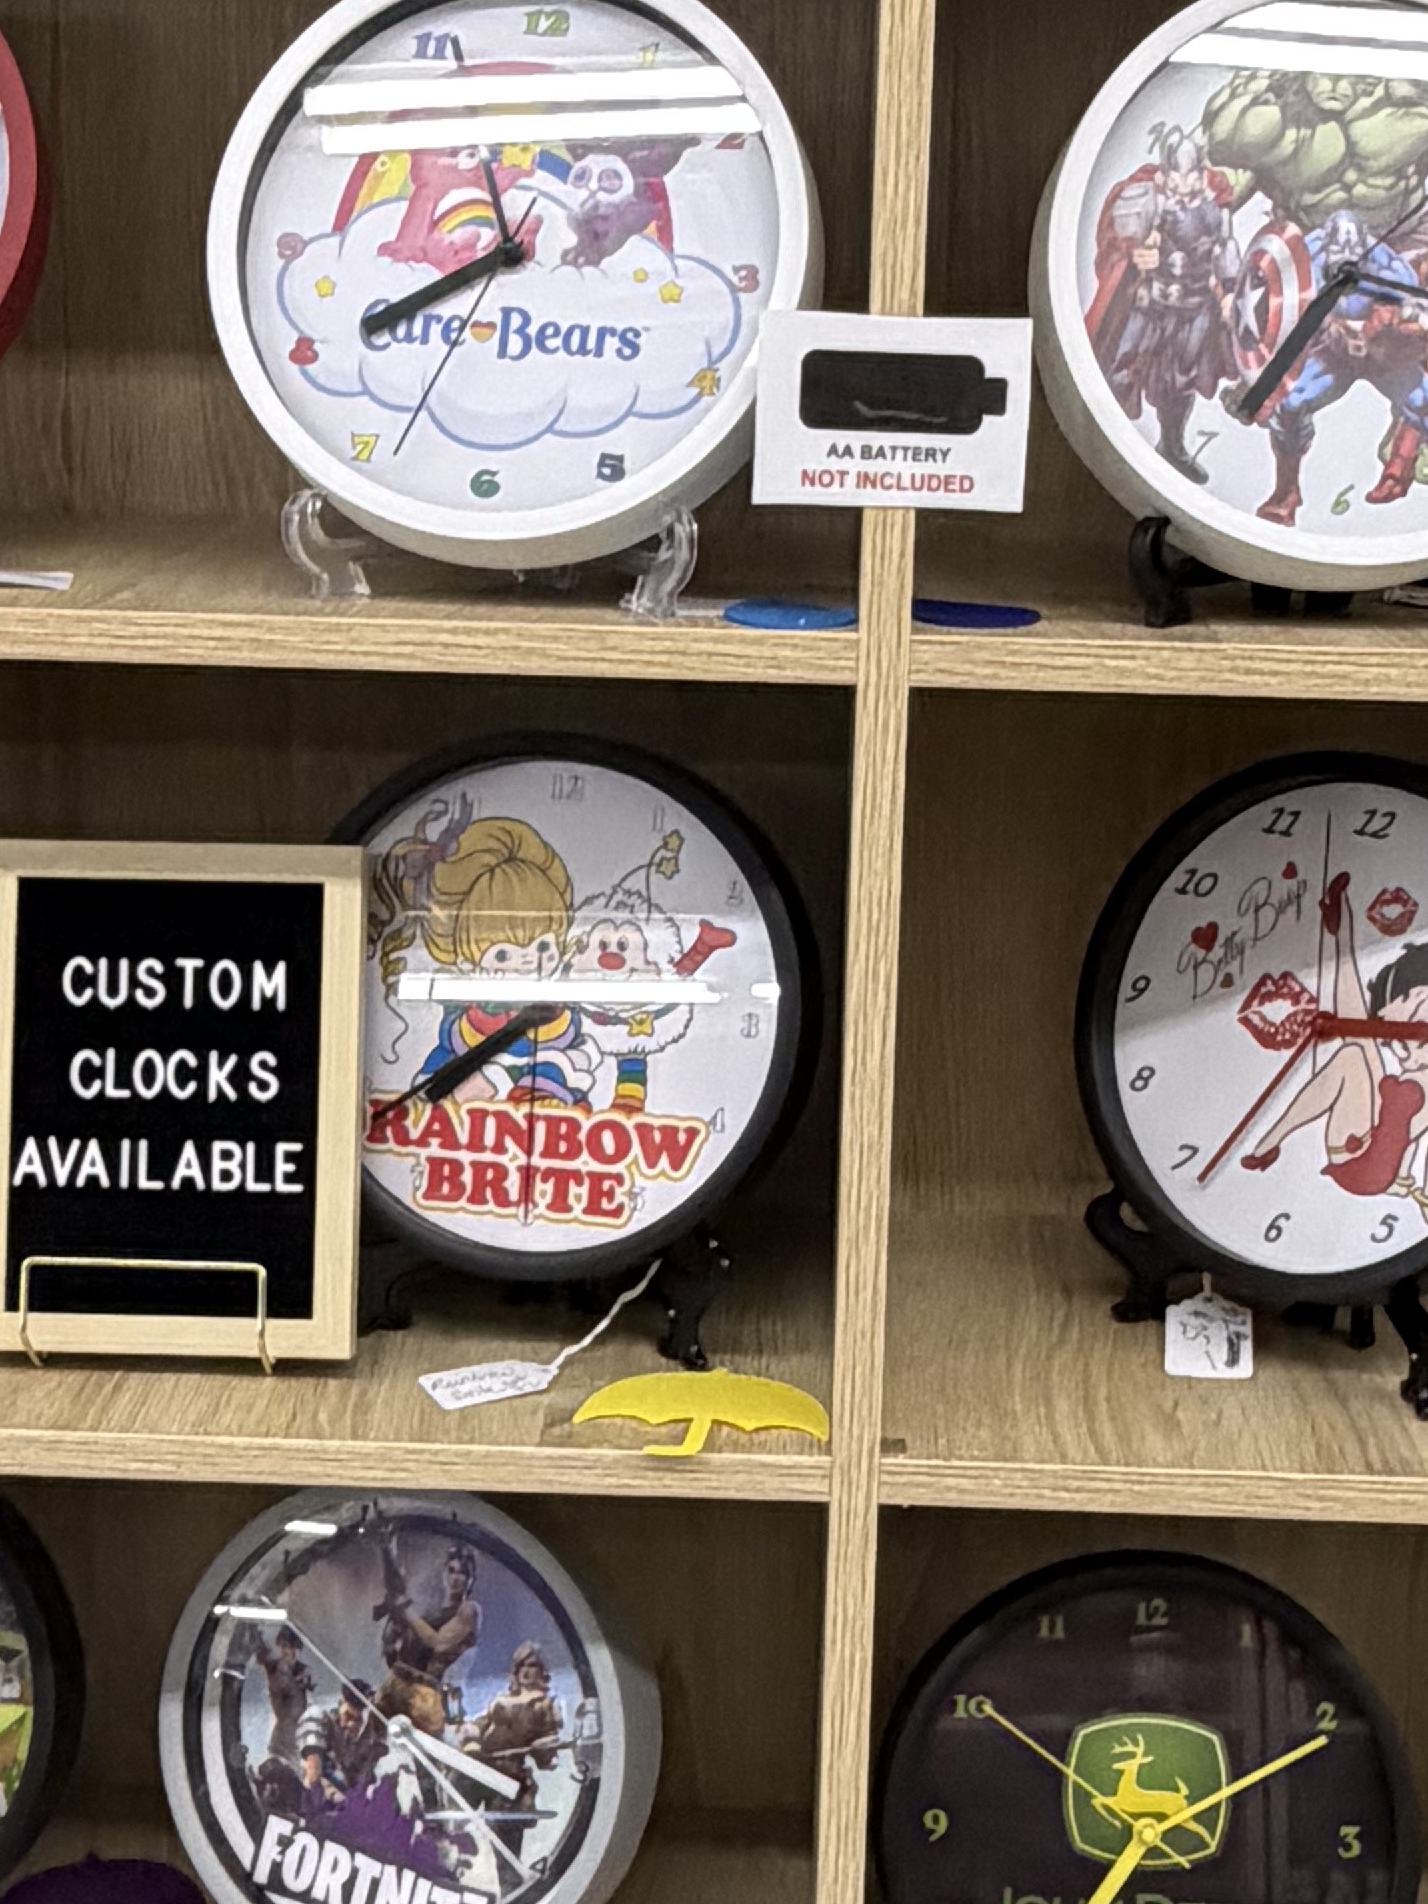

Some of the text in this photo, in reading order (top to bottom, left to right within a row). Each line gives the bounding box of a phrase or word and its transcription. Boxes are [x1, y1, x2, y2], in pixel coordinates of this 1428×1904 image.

[359, 298, 641, 361] Care Bears
[596, 453, 626, 483] 5
[827, 443, 951, 463] AA BATTERY
[470, 469, 501, 498] 6
[800, 469, 974, 493] NOT INCLUDED
[1353, 809, 1396, 839] 12
[1174, 869, 1218, 898] 10
[62, 956, 289, 1012] CUSTOM
[69, 1048, 280, 1103] CLOCKS
[1129, 1066, 1155, 1092] 8
[365, 1099, 701, 1172] RAINBOW
[12, 1137, 305, 1193] AVAILABLE
[422, 1156, 625, 1219] BRITE
[1264, 1213, 1291, 1242] 6
[1135, 1599, 1169, 1627] 12
[923, 1810, 948, 1841] 9
[1338, 1827, 1363, 1858] 3
